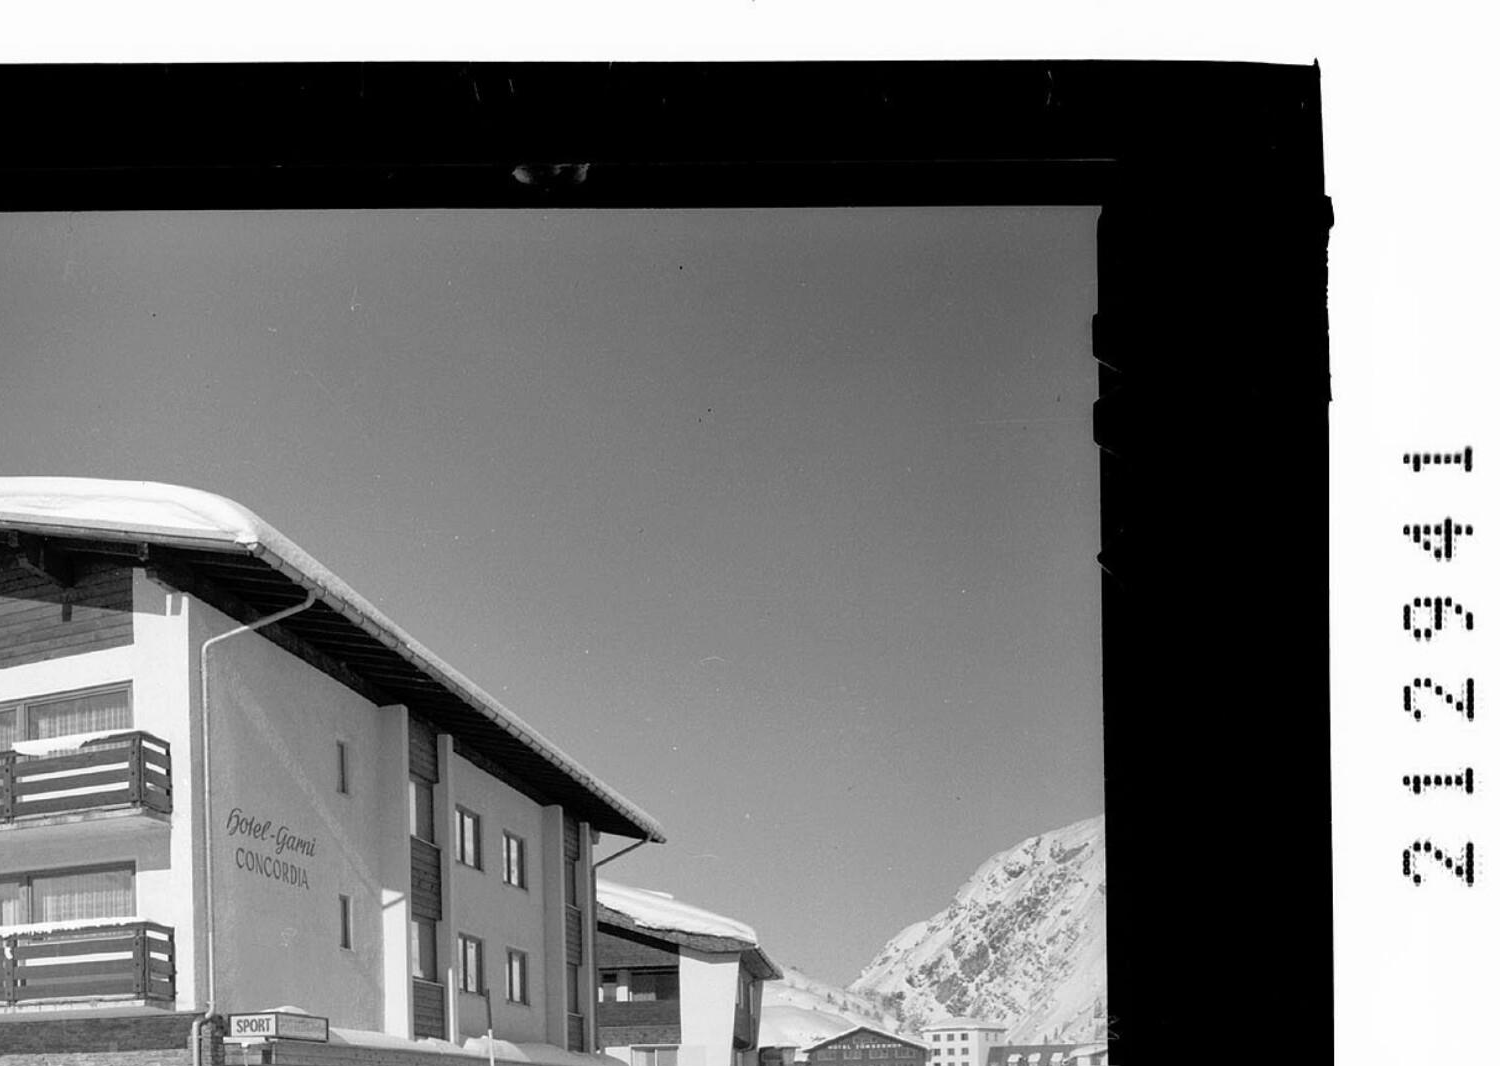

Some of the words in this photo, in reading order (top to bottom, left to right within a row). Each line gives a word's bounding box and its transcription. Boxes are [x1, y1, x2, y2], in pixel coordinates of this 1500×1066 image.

[226, 807, 316, 857] Hotel-Garni
[235, 847, 310, 890] CONCORDIA
[236, 1017, 272, 1034] SPORT
